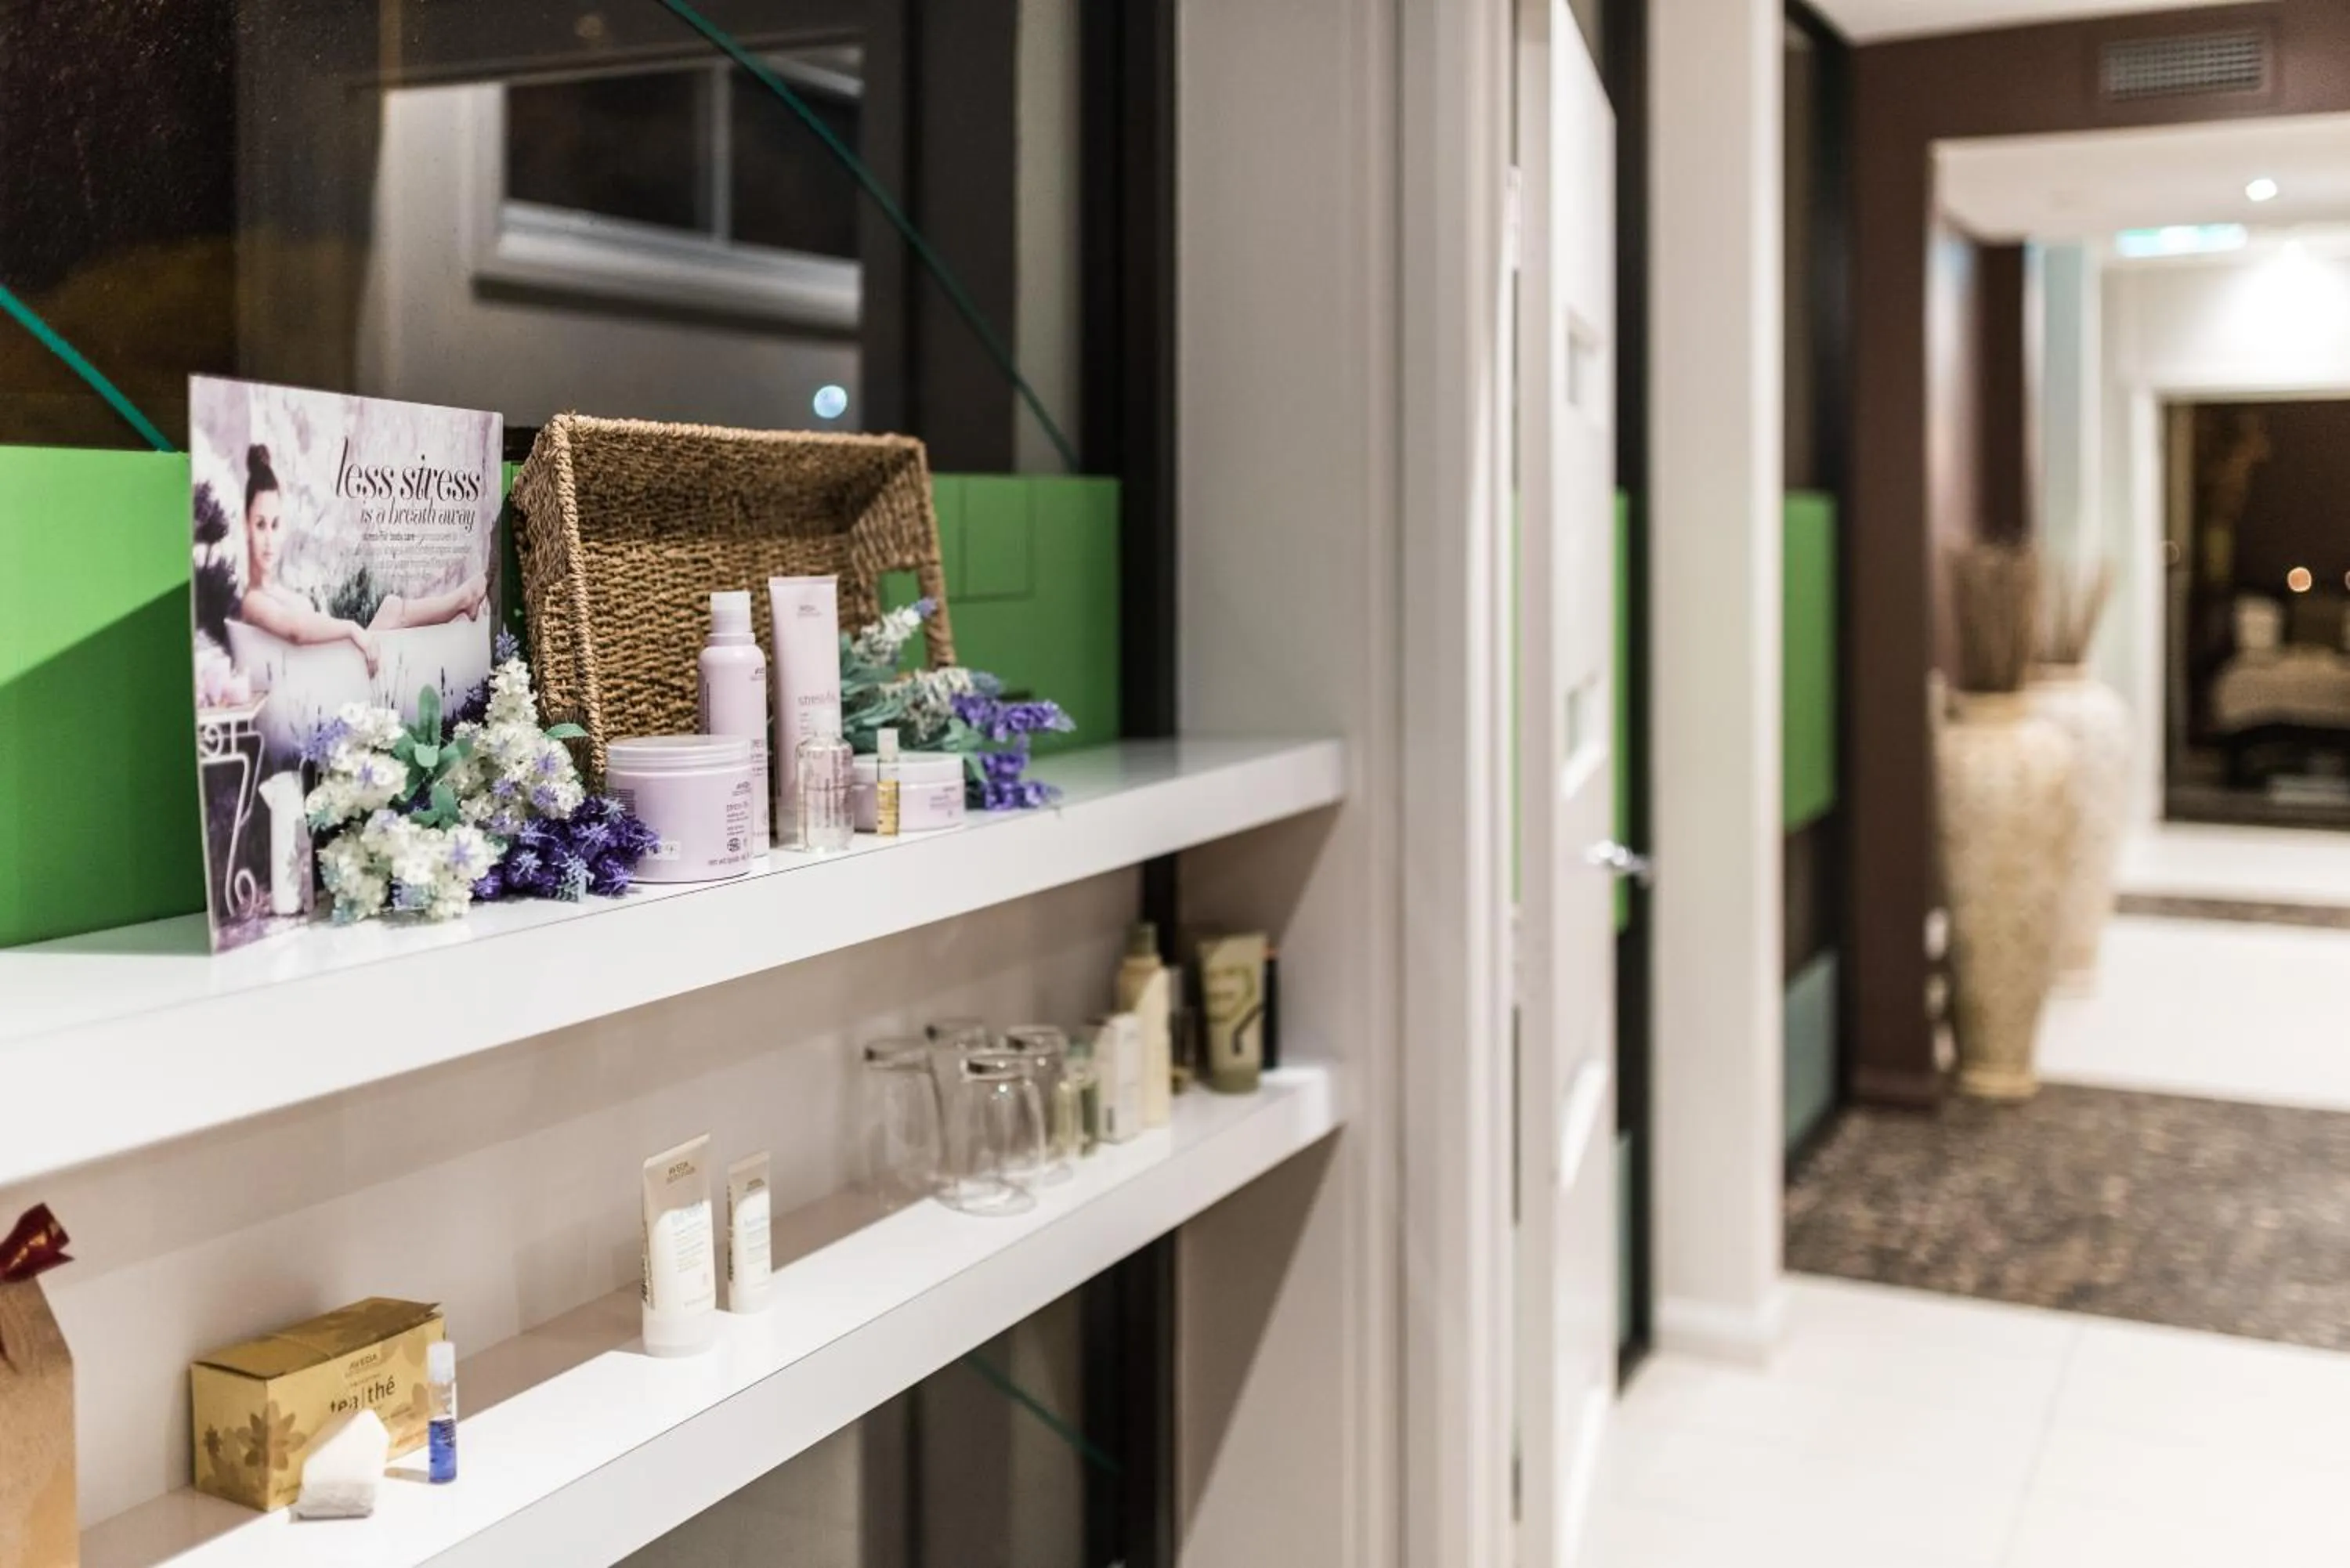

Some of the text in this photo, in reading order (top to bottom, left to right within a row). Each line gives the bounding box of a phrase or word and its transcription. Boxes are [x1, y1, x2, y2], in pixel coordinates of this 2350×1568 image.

[335, 435, 480, 502] less stress
[361, 497, 475, 533] is a breath away
